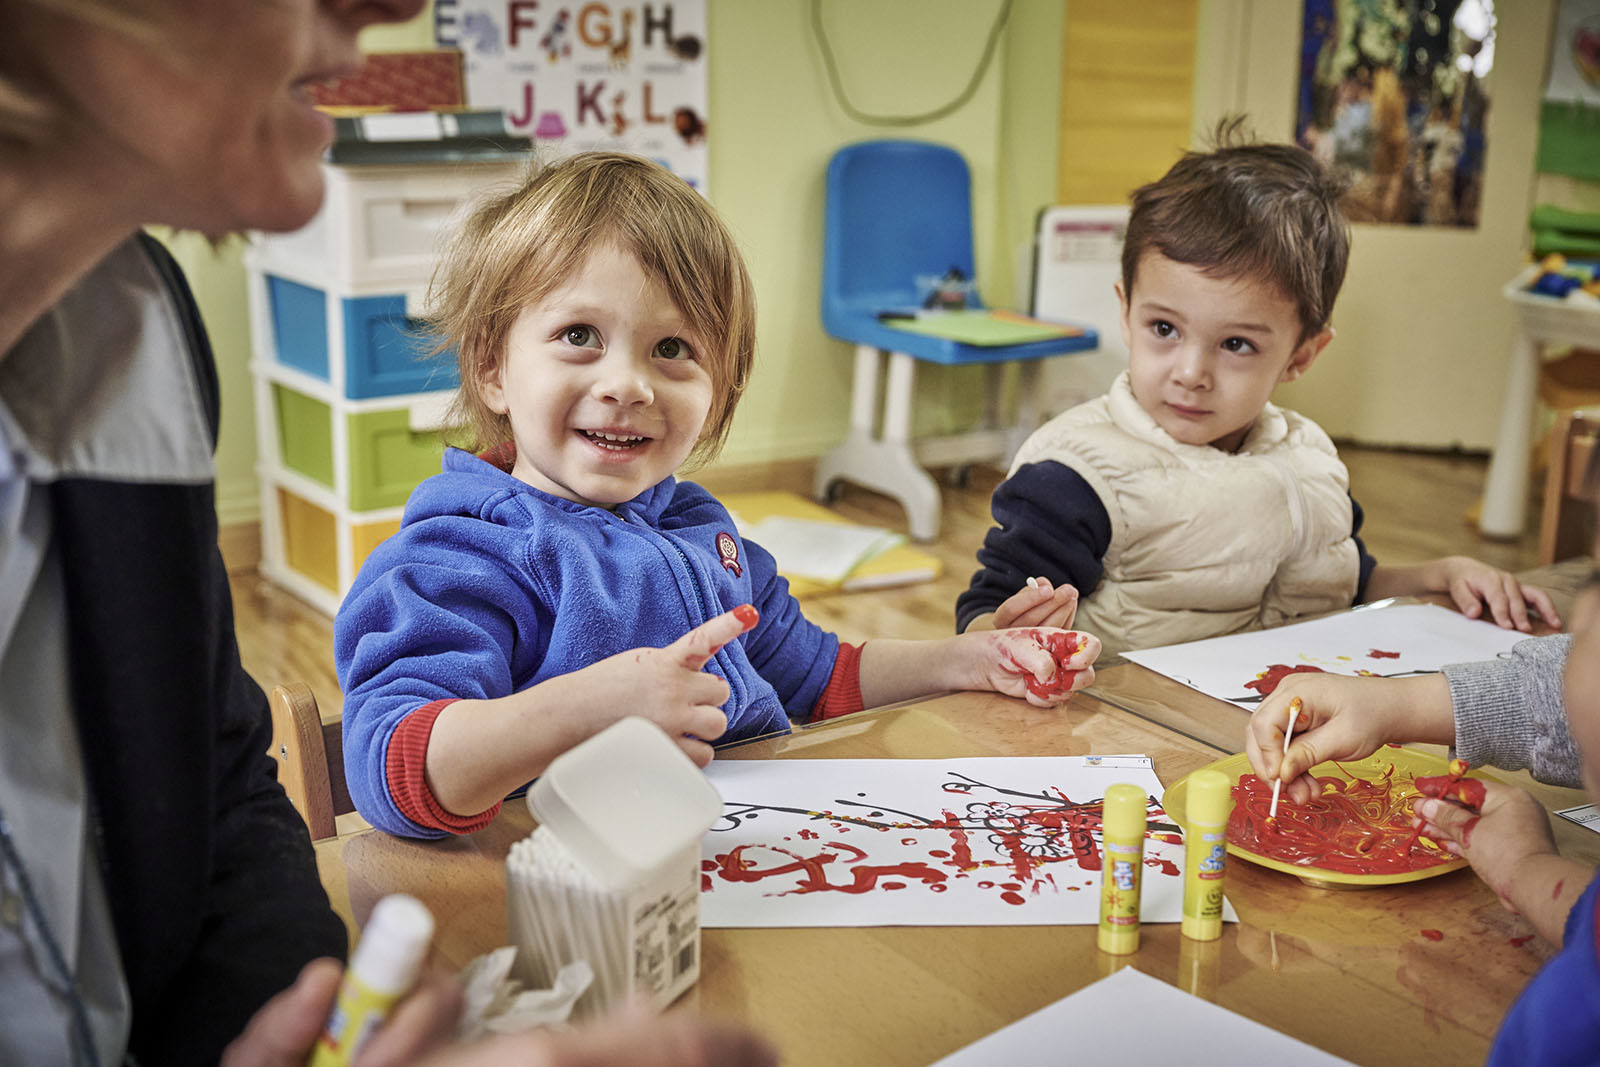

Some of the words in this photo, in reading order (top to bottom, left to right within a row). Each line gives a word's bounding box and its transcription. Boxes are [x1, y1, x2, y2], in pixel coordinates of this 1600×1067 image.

[434, 0, 458, 46] E
[508, 1, 537, 48] F
[577, 3, 613, 48] G
[643, 3, 674, 46] H
[509, 81, 534, 128] J
[577, 81, 607, 125] K
[643, 81, 667, 124] L
